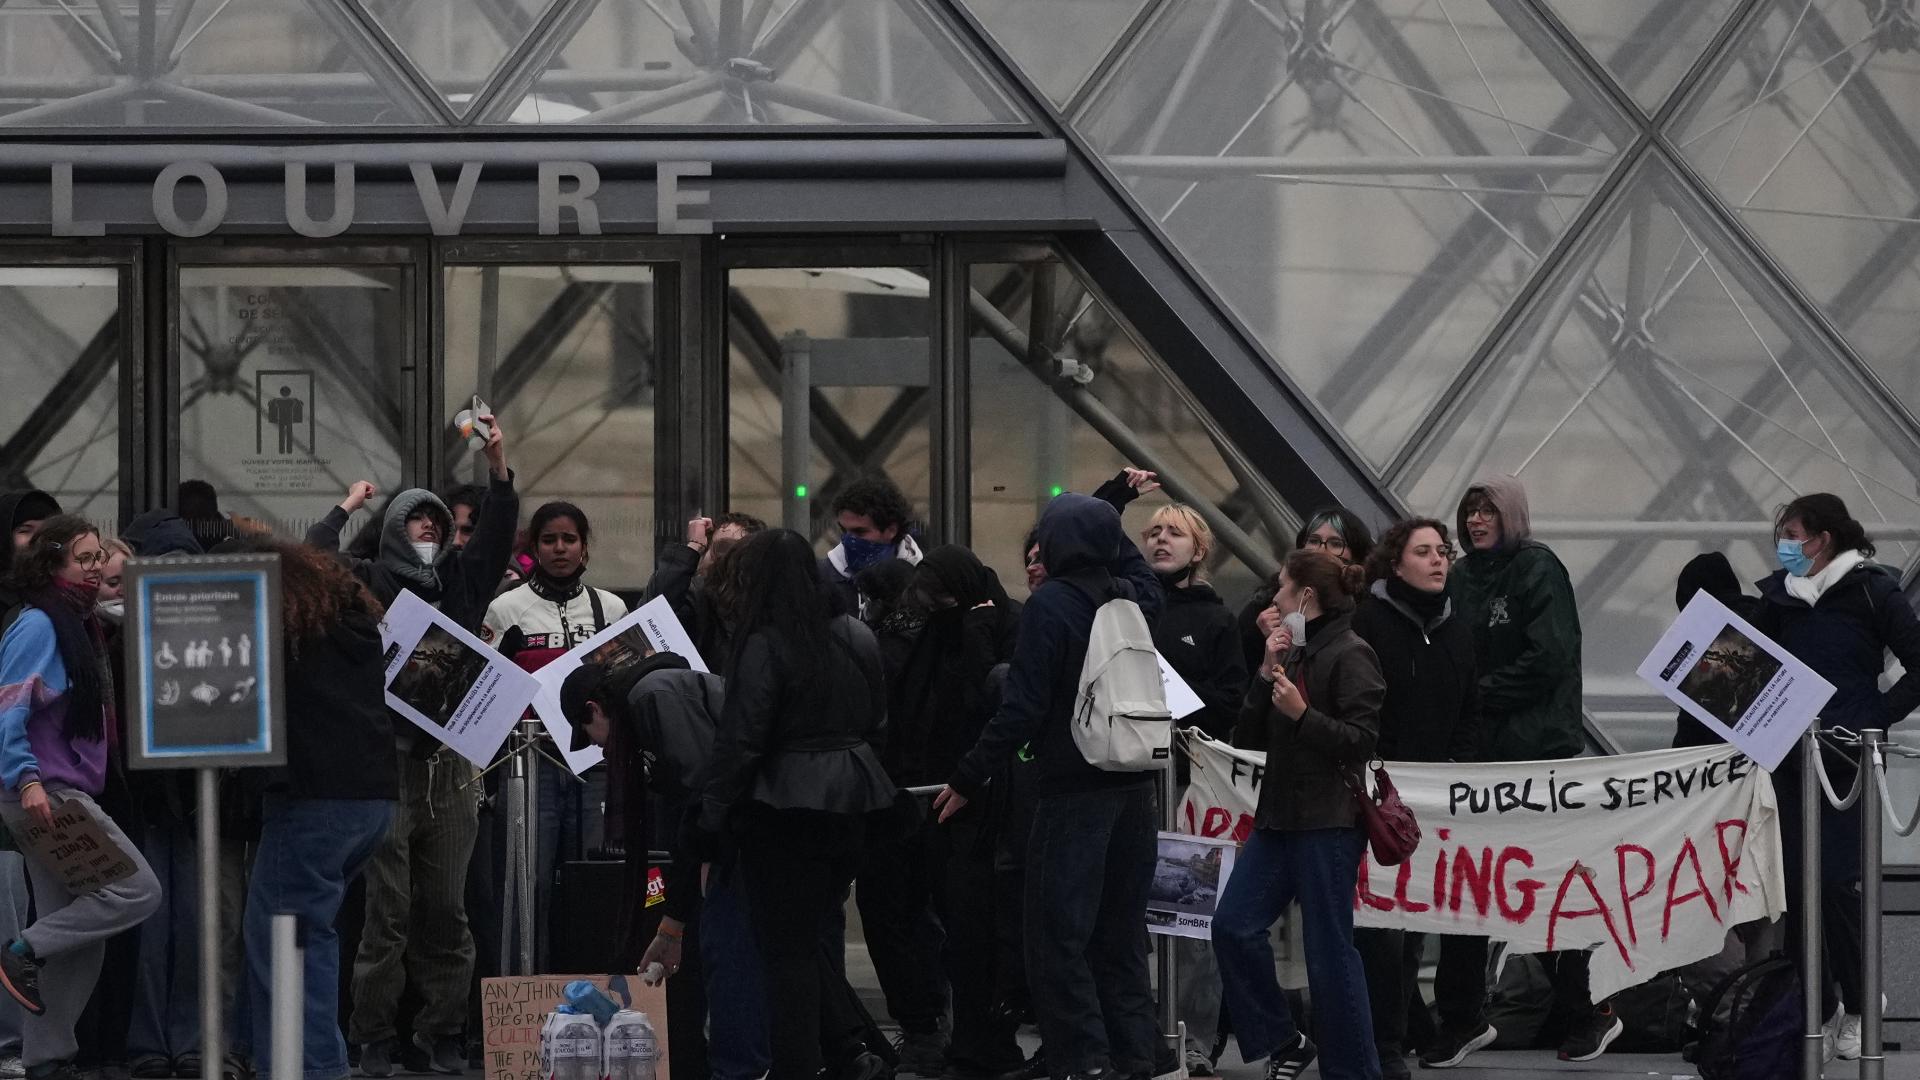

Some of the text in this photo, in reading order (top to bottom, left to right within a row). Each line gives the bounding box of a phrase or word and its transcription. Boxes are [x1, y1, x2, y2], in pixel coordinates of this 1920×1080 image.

[51, 160, 713, 238] LOUVRE
[646, 876, 665, 896] gt
[1545, 818, 1749, 972] APAR
[1178, 917, 1209, 929] SOMBRE
[484, 981, 564, 1002] ANYTHIN
[487, 1000, 530, 1017] THAT
[486, 1013, 548, 1027] DEGRA
[486, 1023, 540, 1047] CULTU
